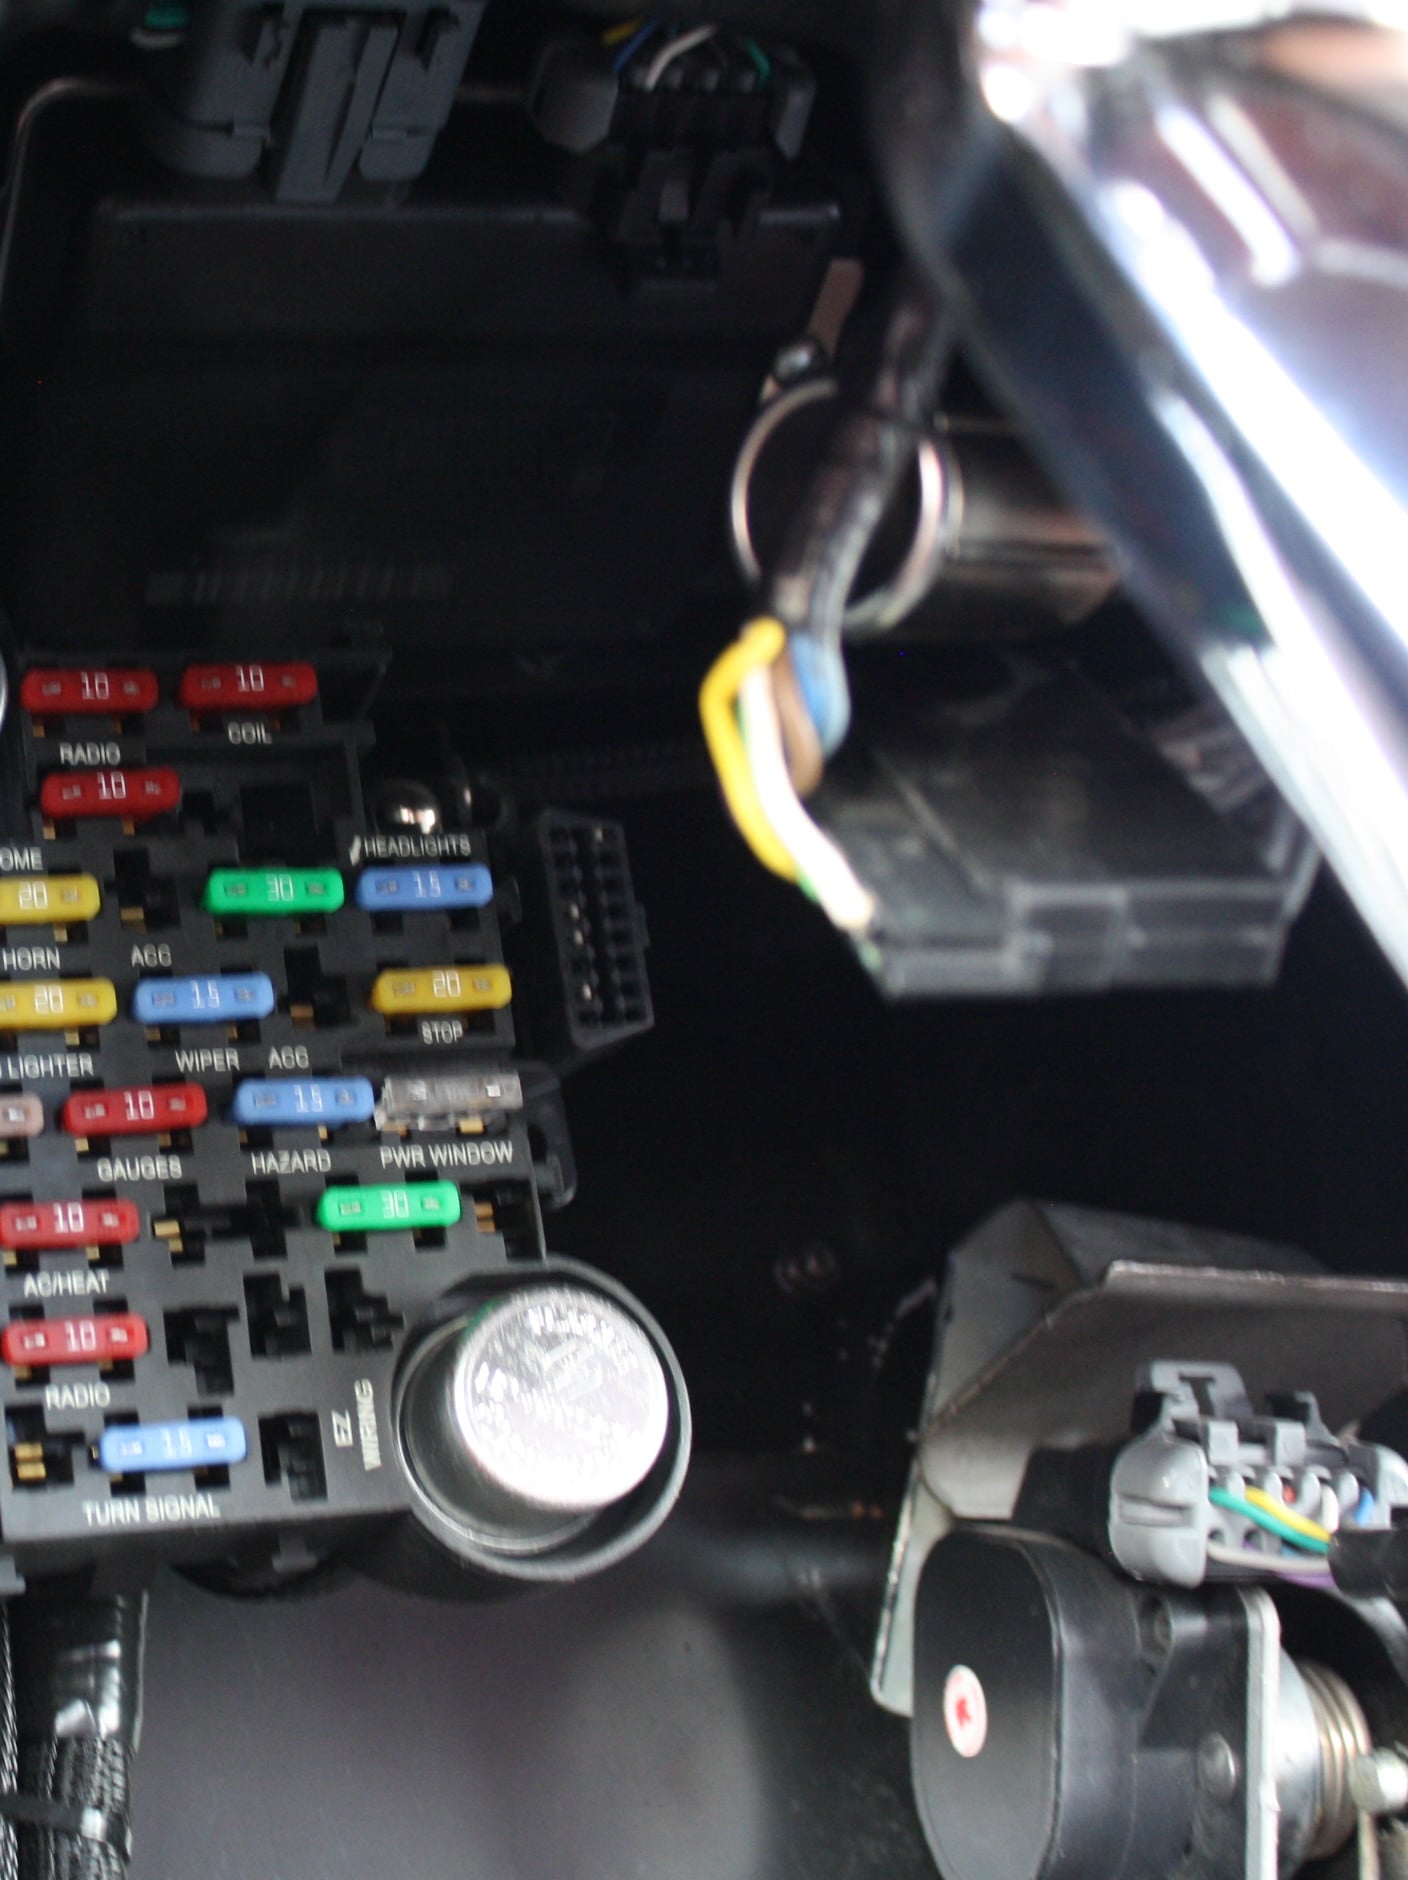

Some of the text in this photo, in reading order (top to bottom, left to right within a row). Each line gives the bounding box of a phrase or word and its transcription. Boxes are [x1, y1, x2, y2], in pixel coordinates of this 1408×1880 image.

[81, 672, 109, 699] 10
[235, 664, 264, 692] 10
[228, 721, 272, 744] COIL
[59, 742, 121, 766] RADIO
[97, 771, 127, 799] 10
[363, 834, 471, 857] HEADLIGHTS
[18, 881, 48, 910] 20
[265, 873, 294, 902] 30
[412, 870, 441, 898] 15
[2, 946, 61, 970] HORN
[131, 944, 172, 967] ACC
[191, 980, 220, 1009] 15
[432, 970, 461, 998] 20
[34, 984, 64, 1014] 20
[422, 1020, 463, 1044] STOP
[7, 1052, 94, 1078] LIGHTER
[176, 1047, 240, 1072] WIPER
[269, 1045, 309, 1069] ACC
[124, 1091, 155, 1120] 10
[294, 1085, 323, 1113] 15
[97, 1155, 182, 1182] GAUGES
[252, 1149, 331, 1175] HAZARD
[381, 1141, 513, 1168] PWR WINDOW
[54, 1202, 85, 1233] 10
[381, 1190, 409, 1218] 30
[65, 1320, 95, 1352] 10
[46, 1382, 110, 1410] RADIO
[331, 1410, 353, 1447] EZ
[83, 1494, 220, 1527] TURN SIGNAL
